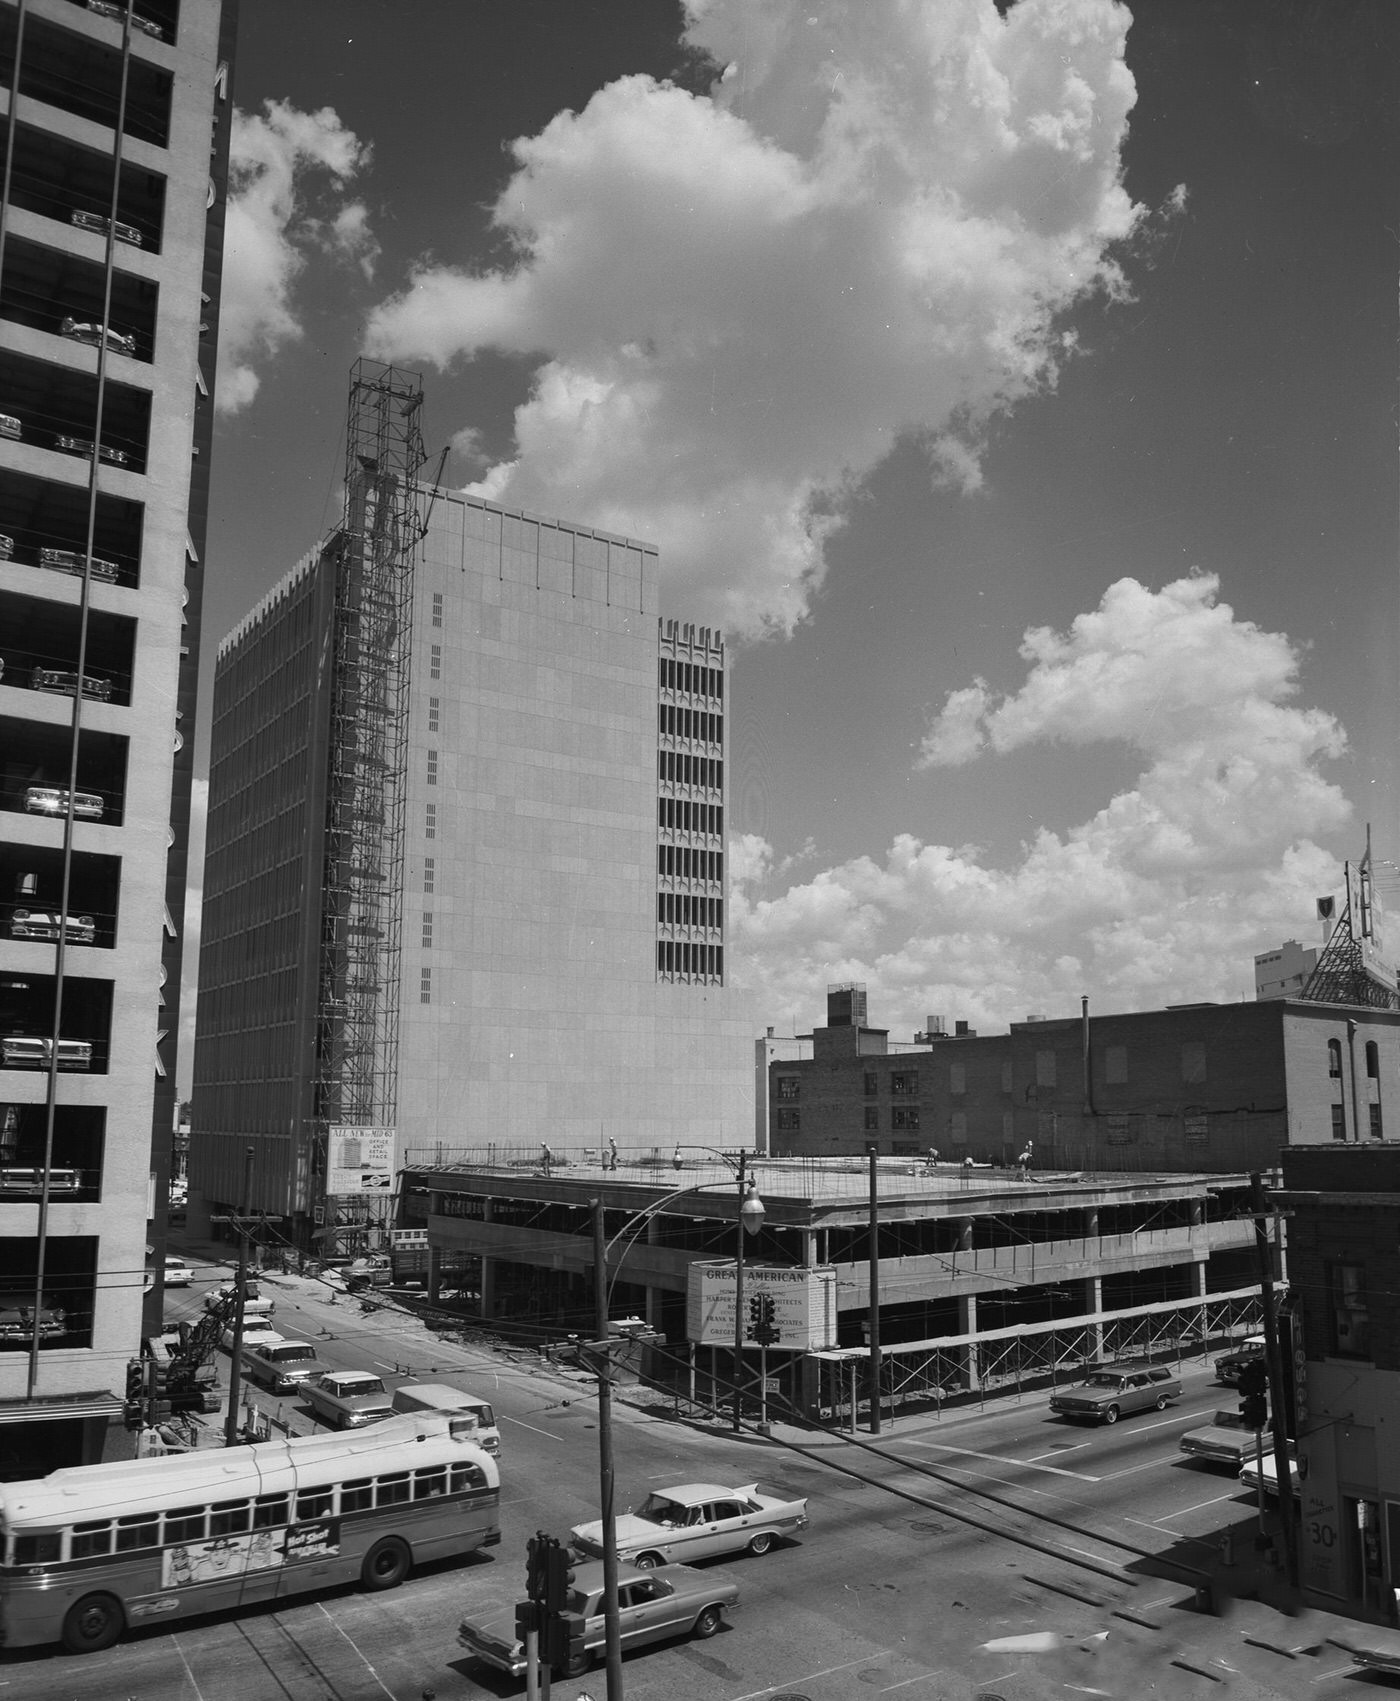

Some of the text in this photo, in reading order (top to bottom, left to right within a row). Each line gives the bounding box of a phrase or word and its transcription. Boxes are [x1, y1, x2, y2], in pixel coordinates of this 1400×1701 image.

[706, 1270, 804, 1282] GREA AMERICAN
[287, 1534, 306, 1548] Hot
[306, 1528, 330, 1544] Shot
